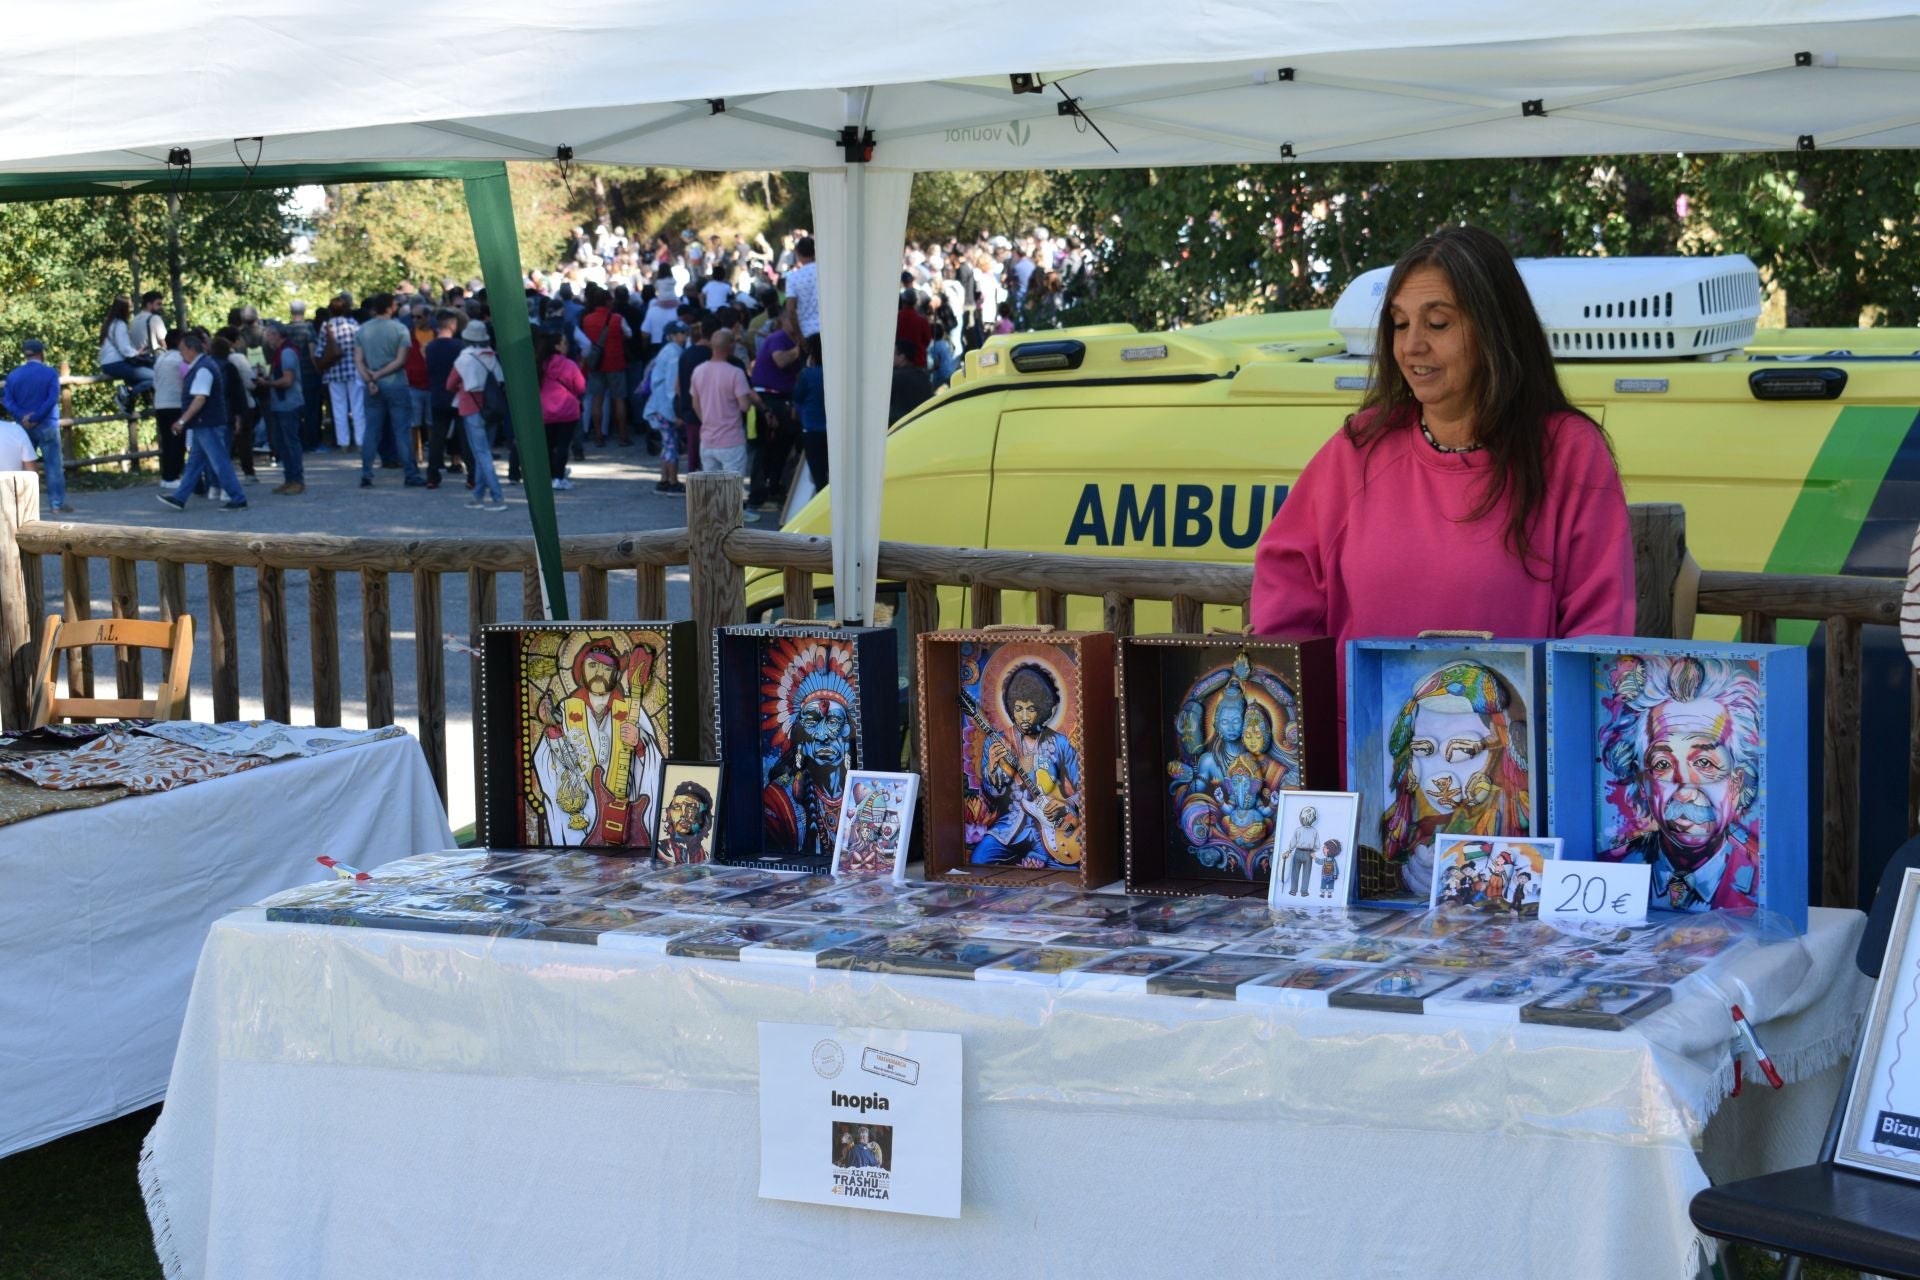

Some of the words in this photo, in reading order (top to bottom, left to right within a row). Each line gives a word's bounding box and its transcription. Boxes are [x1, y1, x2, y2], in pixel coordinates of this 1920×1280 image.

[831, 1090, 890, 1114] Inopia
[1881, 1116, 1920, 1140] Bizu
[833, 1174, 879, 1189] TRASHU
[852, 1169, 865, 1178] XIX
[866, 1171, 890, 1180] FIESTA
[844, 1185, 890, 1200] MANCIA
